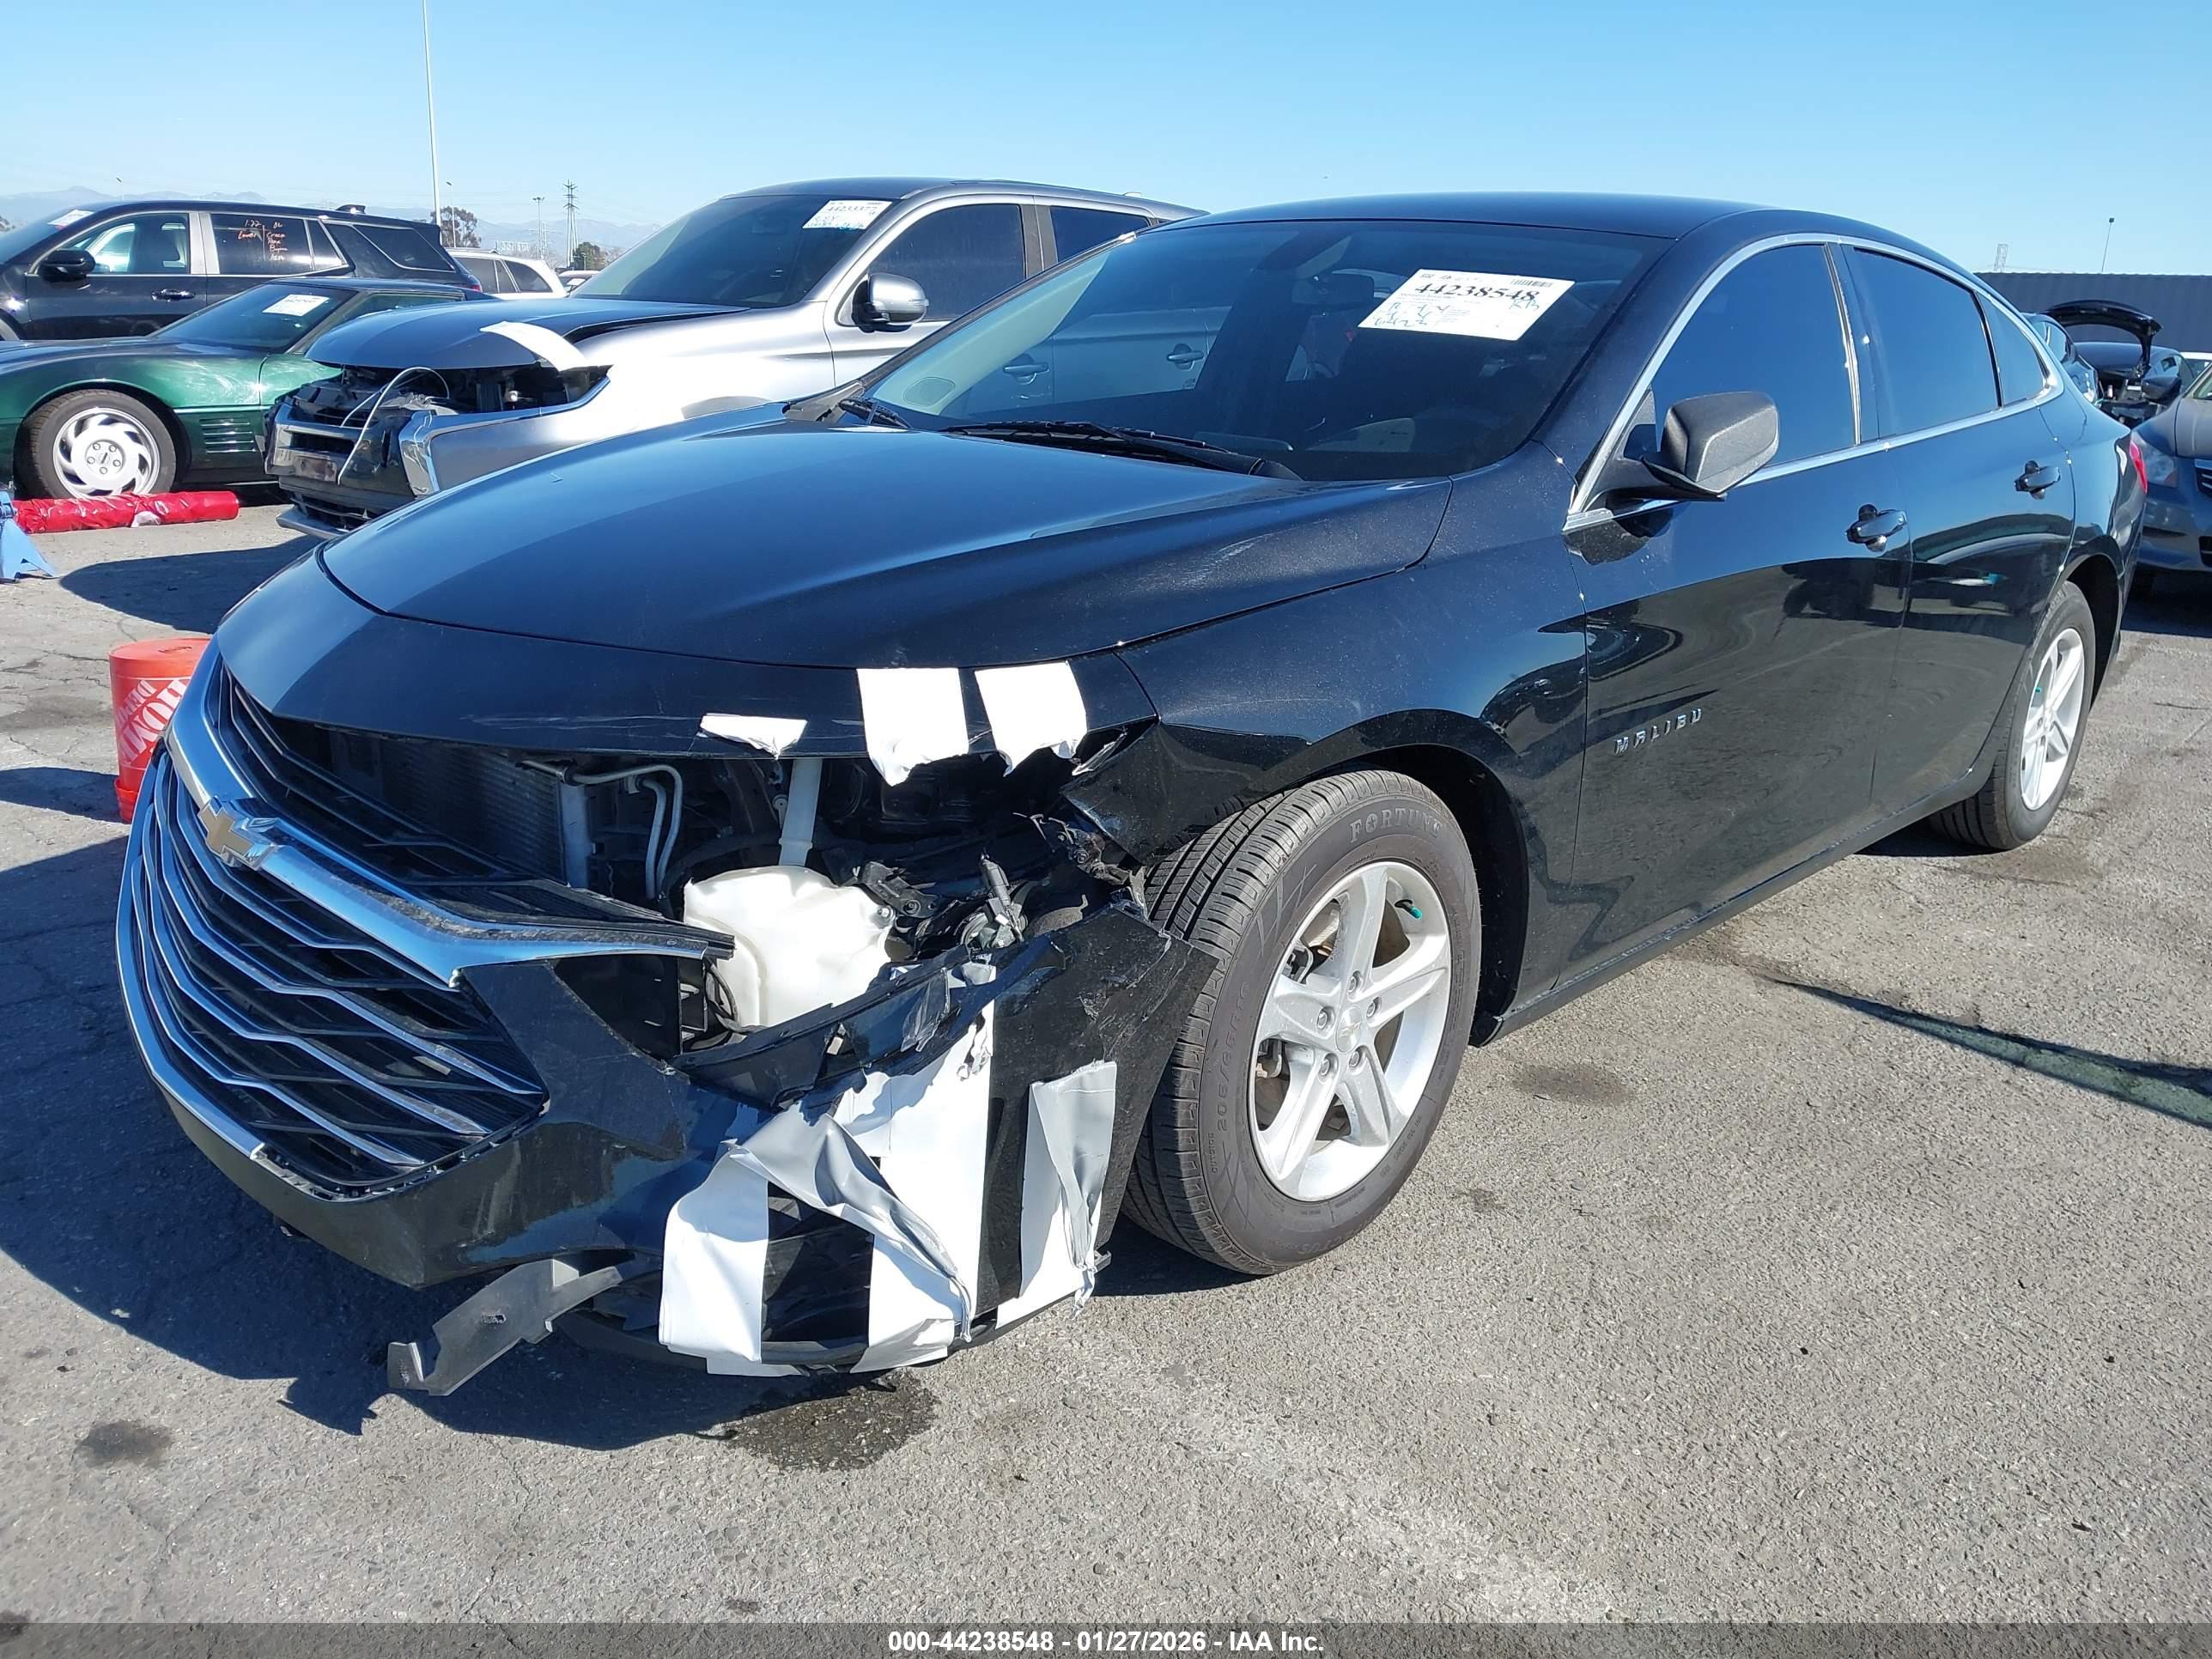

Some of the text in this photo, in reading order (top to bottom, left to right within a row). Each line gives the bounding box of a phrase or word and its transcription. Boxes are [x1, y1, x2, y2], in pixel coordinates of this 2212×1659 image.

[1415, 283, 1540, 301] 44238548
[1614, 708, 1702, 756] MALIBU
[1349, 807, 1443, 844] FORTUNE
[1207, 1132, 1218, 1174] OUTSIDE
